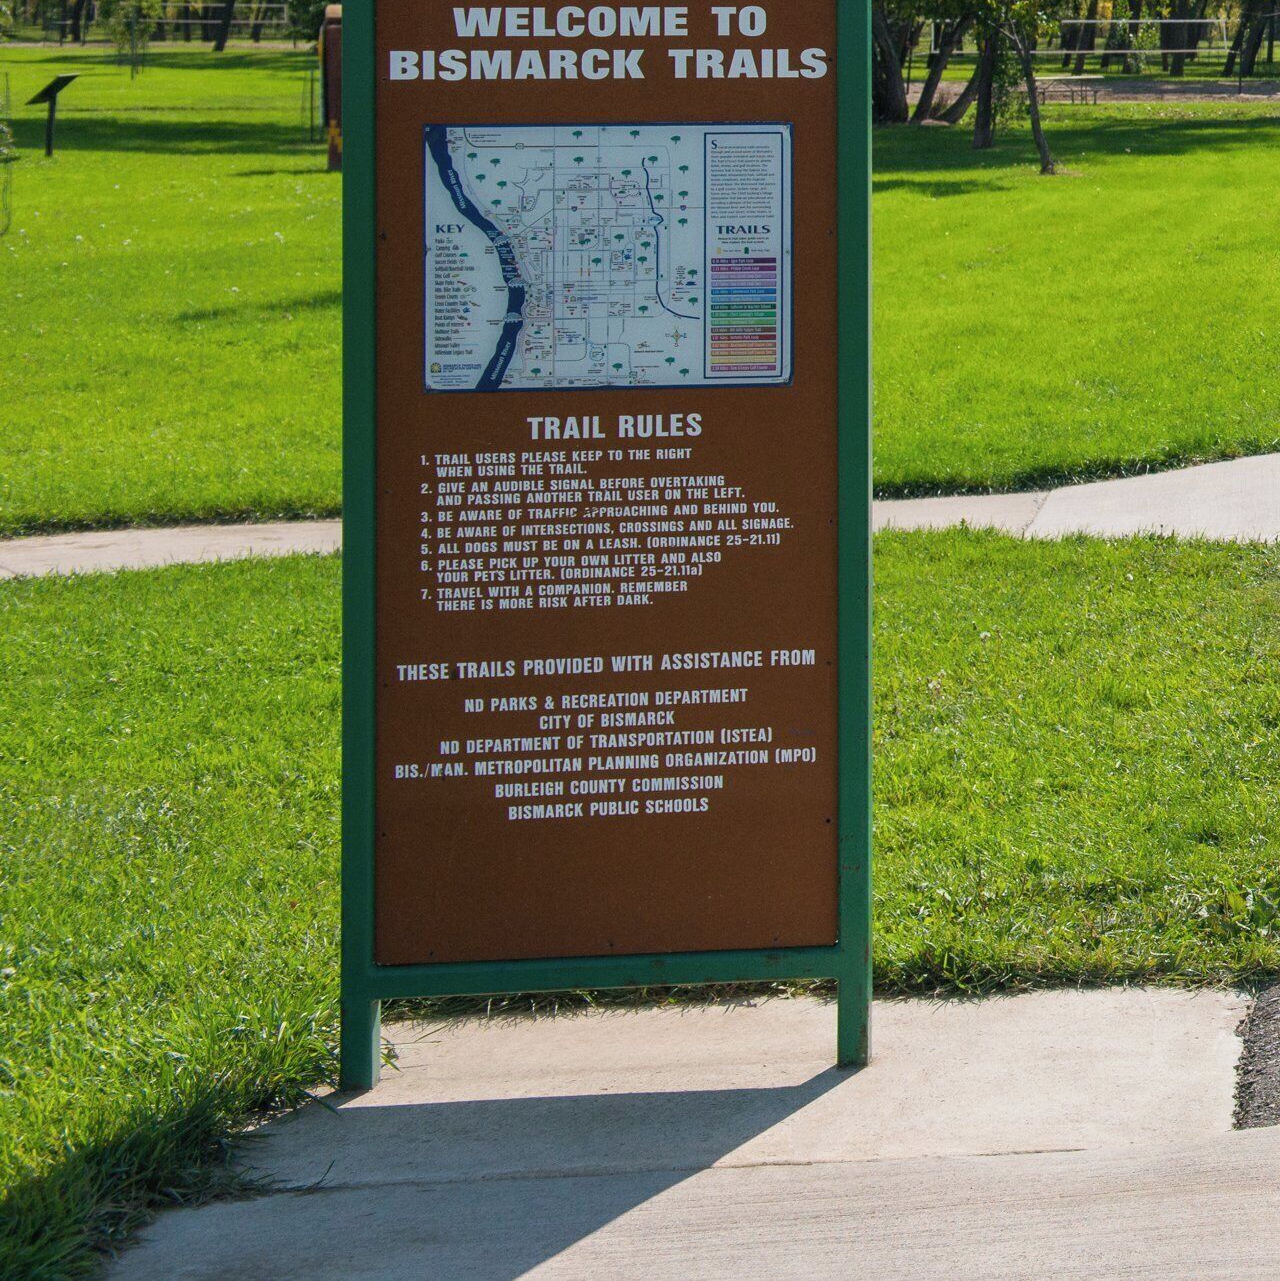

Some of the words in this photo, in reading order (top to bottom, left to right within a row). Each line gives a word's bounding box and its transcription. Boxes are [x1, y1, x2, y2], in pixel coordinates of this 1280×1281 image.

[453, 6, 688, 37] WELCOME
[711, 5, 766, 37] TO
[389, 48, 645, 81] BISMARCK
[668, 48, 827, 79] TRAILS
[436, 224, 464, 233] KEY
[716, 225, 771, 234] TRAILS
[526, 416, 605, 440] TRAIL
[618, 413, 702, 438] RULES
[421, 455, 429, 465] 1.
[434, 454, 470, 465] TRAIL
[475, 453, 516, 464] USERS
[521, 451, 566, 463] PLEASE
[572, 450, 603, 462] KEEP
[607, 450, 623, 461] TO
[628, 449, 650, 460] THE
[656, 448, 692, 459] RIGHT
[436, 466, 472, 477] WHEN
[477, 465, 515, 477] USING
[520, 464, 543, 475] THE
[548, 463, 587, 474] TRAIL.
[421, 483, 432, 494] 2.
[438, 482, 465, 494] GIVE
[471, 481, 488, 493] AN
[493, 480, 544, 492] AUDIBLE
[550, 479, 594, 491] SIGNAL
[600, 477, 645, 489] BEFORE
[650, 475, 725, 488] OVERTAKING
[436, 495, 462, 506] AND
[467, 493, 521, 505] PASSING
[526, 491, 582, 503] ANOTHER
[587, 489, 623, 502] TRAIL
[627, 489, 659, 501] USER
[664, 489, 681, 500] ON
[686, 488, 708, 499] THE
[714, 487, 745, 498] LEFT.
[421, 511, 432, 523] 3.
[438, 511, 453, 522] BE
[459, 509, 502, 521] AWARE
[508, 509, 522, 520] OF
[527, 507, 577, 519] TRAFFIC
[673, 504, 698, 515] AND
[703, 503, 747, 514] BEHIND
[753, 502, 779, 513] YOU.
[420, 528, 432, 539] 4.
[437, 527, 451, 538] BE
[456, 526, 497, 538] AWARE
[502, 525, 516, 537] OF
[521, 523, 614, 536] INTERSECTIONS,
[619, 521, 684, 533] CROSSINGS
[689, 520, 712, 531] AND
[717, 519, 737, 531] ALL
[742, 518, 794, 530] SIGNAGE.
[420, 544, 432, 555] 5.
[438, 543, 460, 554] ALL
[465, 541, 497, 553] DOGS
[503, 540, 538, 552] MUST
[543, 540, 558, 551] BE
[563, 539, 580, 550] ON
[586, 539, 594, 550] A
[599, 538, 641, 549] LEASH.
[647, 535, 721, 549] (ORDINANCE
[726, 532, 780, 546] 25-21.11)
[420, 560, 432, 571] 6.
[438, 558, 484, 571] PLEASE
[489, 557, 517, 569] PICK
[523, 557, 539, 568] UP
[544, 556, 575, 567] YOUR
[581, 555, 609, 566] OWN
[614, 553, 655, 565] LITTER
[661, 553, 686, 564] AND
[691, 551, 721, 563] ALSO
[436, 571, 468, 583] YOUR
[510, 569, 555, 581] LITTER.
[560, 566, 635, 580] (ORDINANCE
[641, 563, 702, 577] 25-21.11a)
[421, 589, 432, 600] 7.
[437, 587, 483, 599] TRAVEL
[488, 586, 519, 597] WITH
[525, 585, 533, 596] A
[538, 583, 614, 596] COMPANION.
[620, 581, 687, 593] REMEMBER
[436, 599, 475, 611] THERE
[481, 599, 493, 610] IS
[499, 598, 533, 609] MORE
[539, 597, 567, 608] RISK
[573, 595, 611, 607] AFTER
[617, 594, 653, 605] DARK.
[396, 663, 449, 681] THESE
[456, 660, 515, 679] TRAILS
[523, 657, 603, 676] PROVIDED
[611, 655, 653, 672] WITH
[660, 651, 763, 670] ASSISTANCE
[771, 649, 815, 666] FROM
[464, 699, 484, 713] ND
[491, 696, 537, 712] PARKS
[544, 696, 554, 710] &
[561, 692, 648, 709] RECREATION
[655, 688, 748, 705] DEPARTMENT
[539, 715, 571, 730] CITY
[577, 714, 594, 728] OF
[601, 711, 675, 727] BISMARCK
[440, 741, 459, 755] ND
[466, 736, 561, 754] DEPARTMENT
[567, 735, 584, 750] OF
[589, 730, 714, 748] TRANSPORTATION
[720, 727, 772, 744] (ISTEA)
[474, 757, 582, 776] METROPOLITAN
[588, 754, 659, 770] PLANNING
[665, 750, 768, 767] ORGANIZATION
[775, 747, 816, 764] (MPO)
[495, 781, 563, 798] BURLEIGH
[570, 778, 626, 795] COUNTY
[632, 775, 723, 792] COMMISSION
[508, 803, 583, 820] BISMARCK
[590, 800, 639, 816] PUBLIC
[645, 797, 708, 814] SCHOOLS
